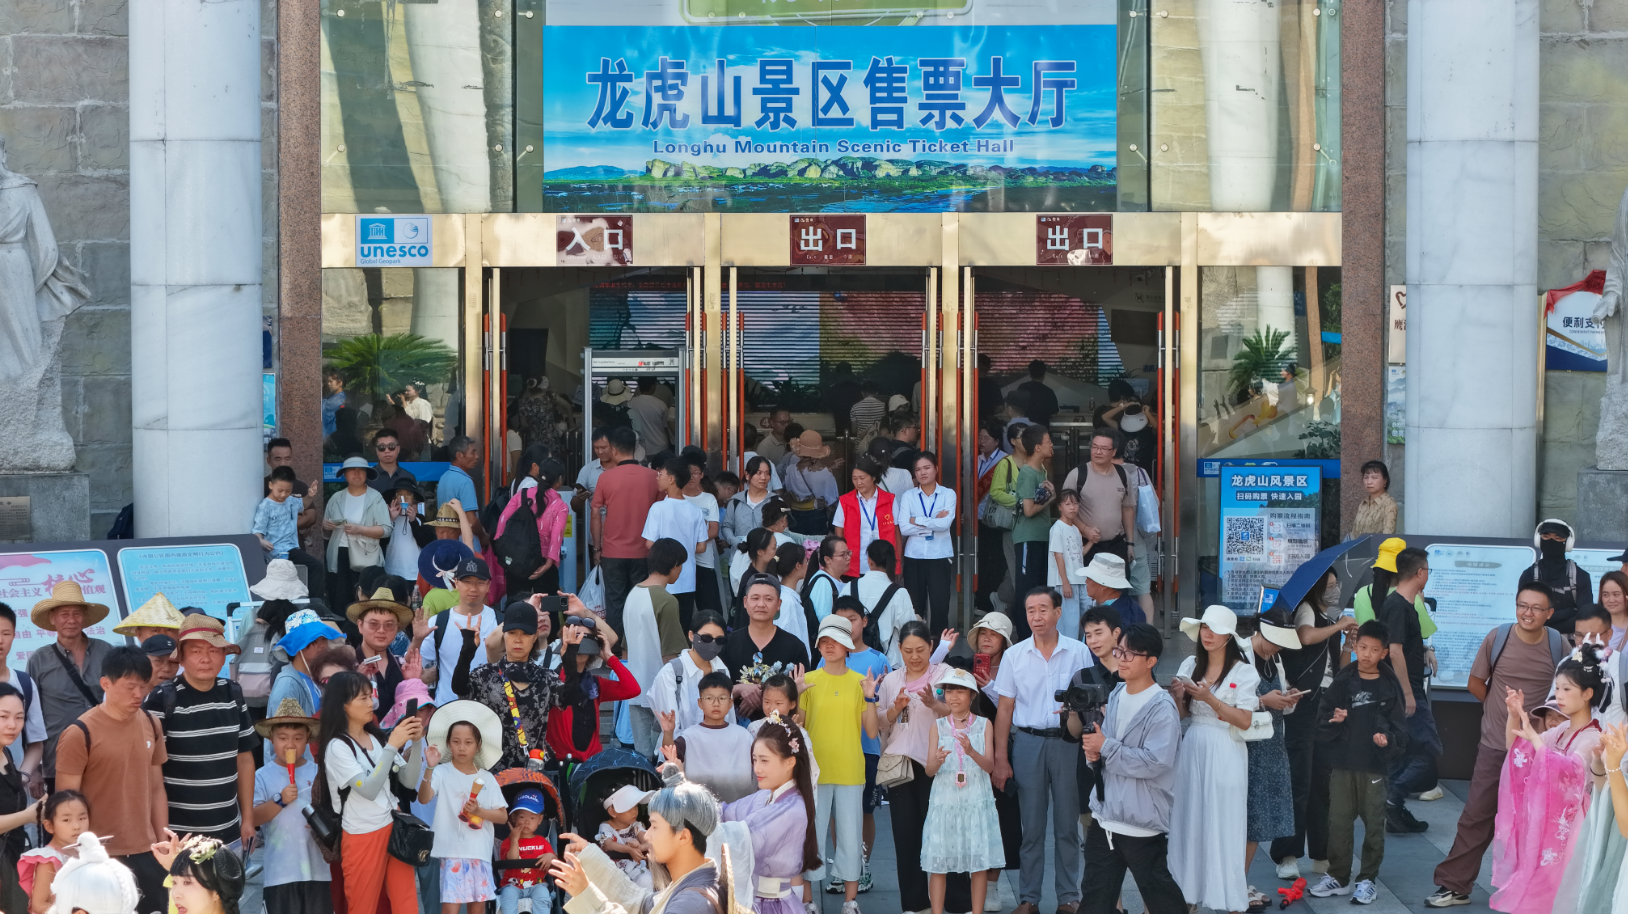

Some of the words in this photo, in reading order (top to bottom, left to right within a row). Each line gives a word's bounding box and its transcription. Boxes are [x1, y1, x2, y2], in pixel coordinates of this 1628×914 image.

[586, 56, 1078, 131] 龙虎山景区售票大厅
[653, 140, 728, 155] Longhu
[735, 139, 829, 153] Mountain
[837, 139, 902, 153] Scenic
[909, 139, 969, 153] Ticket
[976, 139, 1014, 153] Hall
[566, 227, 623, 251] 入口
[800, 226, 856, 251] 出口
[1047, 226, 1103, 251] 出口
[360, 245, 429, 257] unesco
[1231, 475, 1308, 487] 龙虎山风景区
